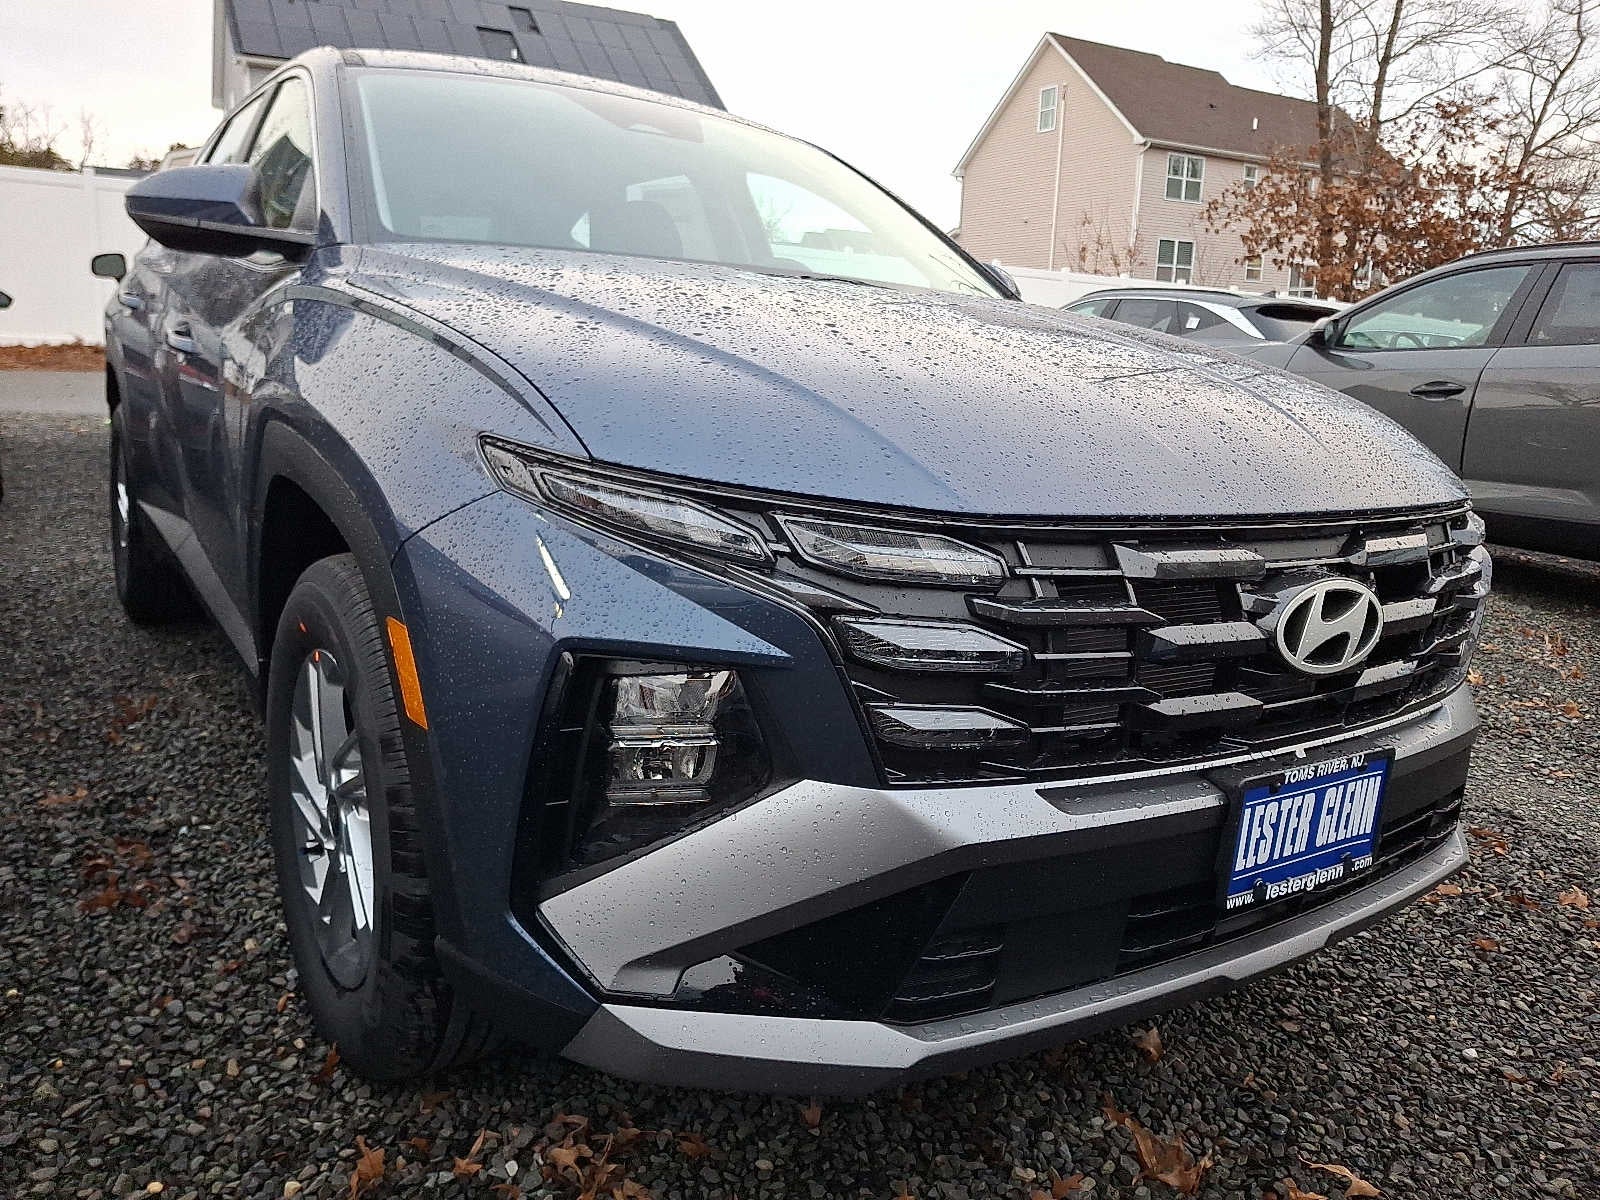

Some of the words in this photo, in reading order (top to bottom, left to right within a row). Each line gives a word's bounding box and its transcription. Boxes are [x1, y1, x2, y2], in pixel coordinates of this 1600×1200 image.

[1284, 767, 1315, 784] TOMS
[1317, 758, 1349, 777] RIVER,
[1351, 754, 1365, 769] NJ
[1235, 792, 1316, 872] LESTER
[1316, 776, 1382, 847] GLENN
